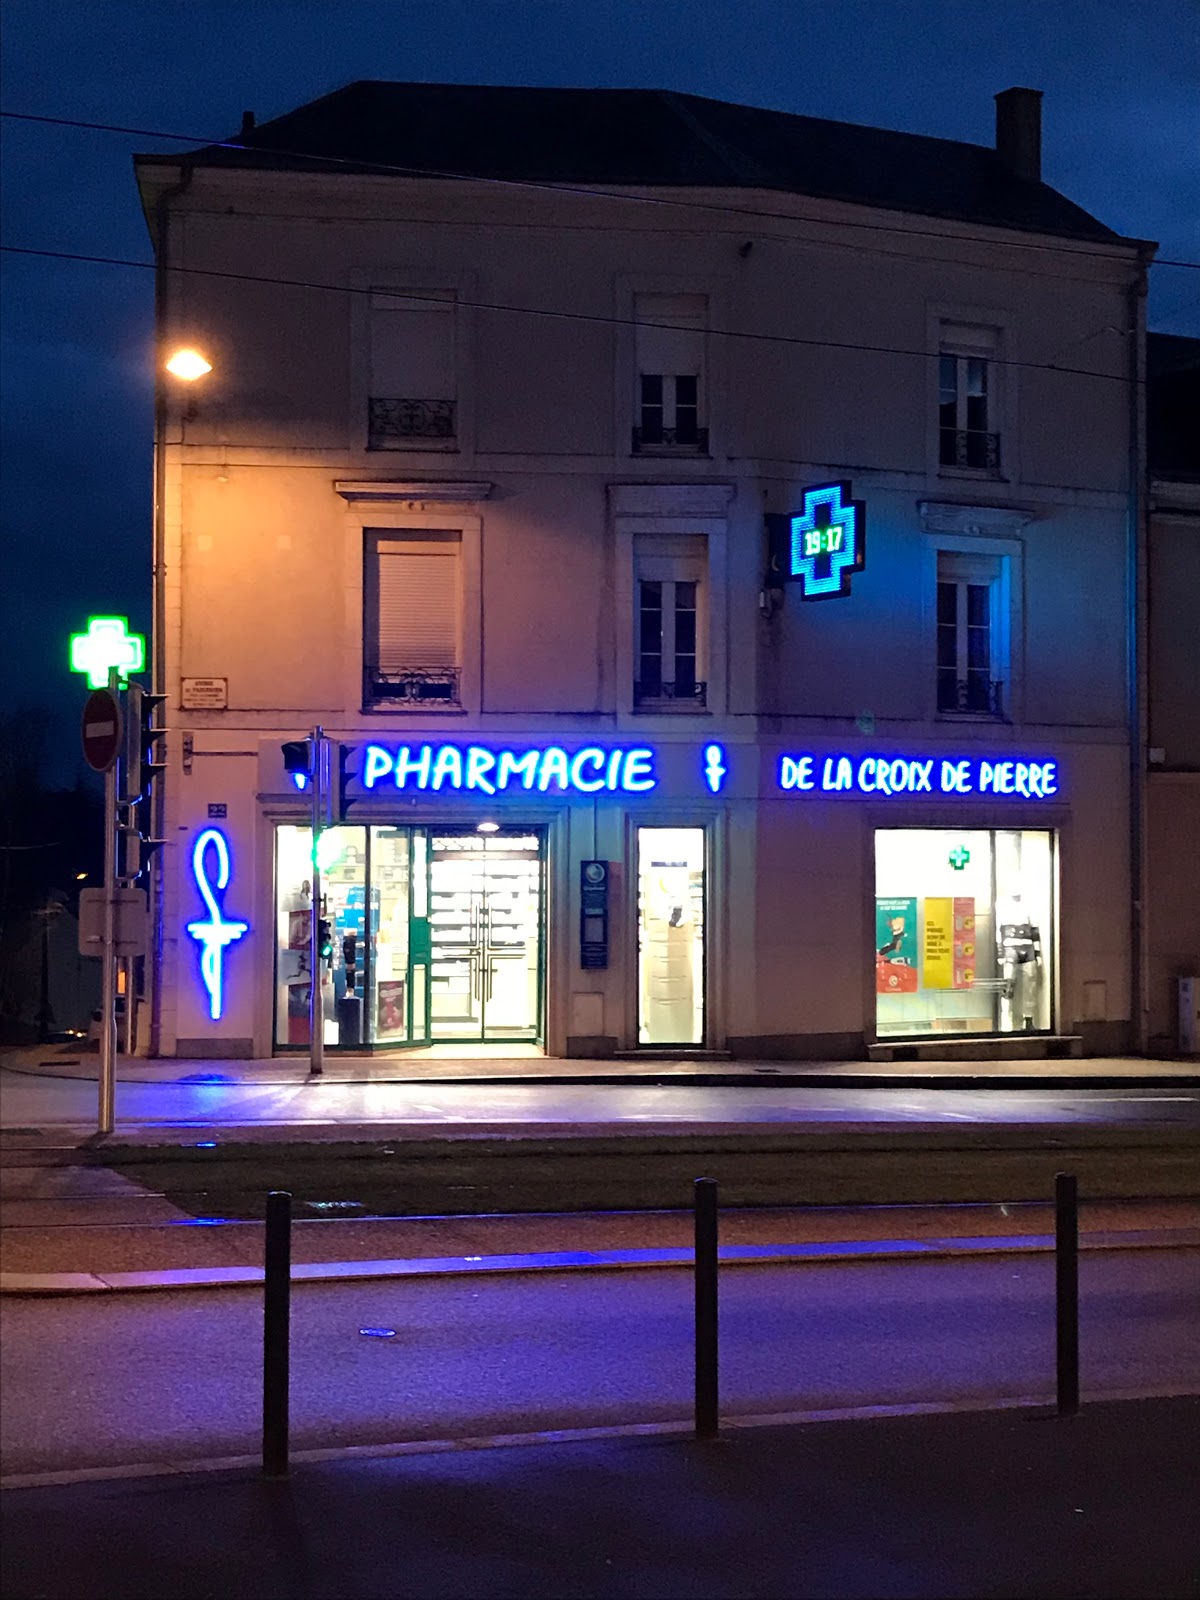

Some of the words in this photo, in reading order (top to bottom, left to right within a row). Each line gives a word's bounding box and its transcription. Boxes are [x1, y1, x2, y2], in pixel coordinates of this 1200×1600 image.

[805, 526, 842, 556] 19:17
[364, 745, 656, 795] PHARMACIE
[781, 756, 815, 790] DE
[822, 757, 853, 791] LA
[857, 757, 934, 796] CROIX
[940, 760, 973, 793] DE
[979, 760, 1058, 799] PIERRE
[209, 805, 225, 816] 22
